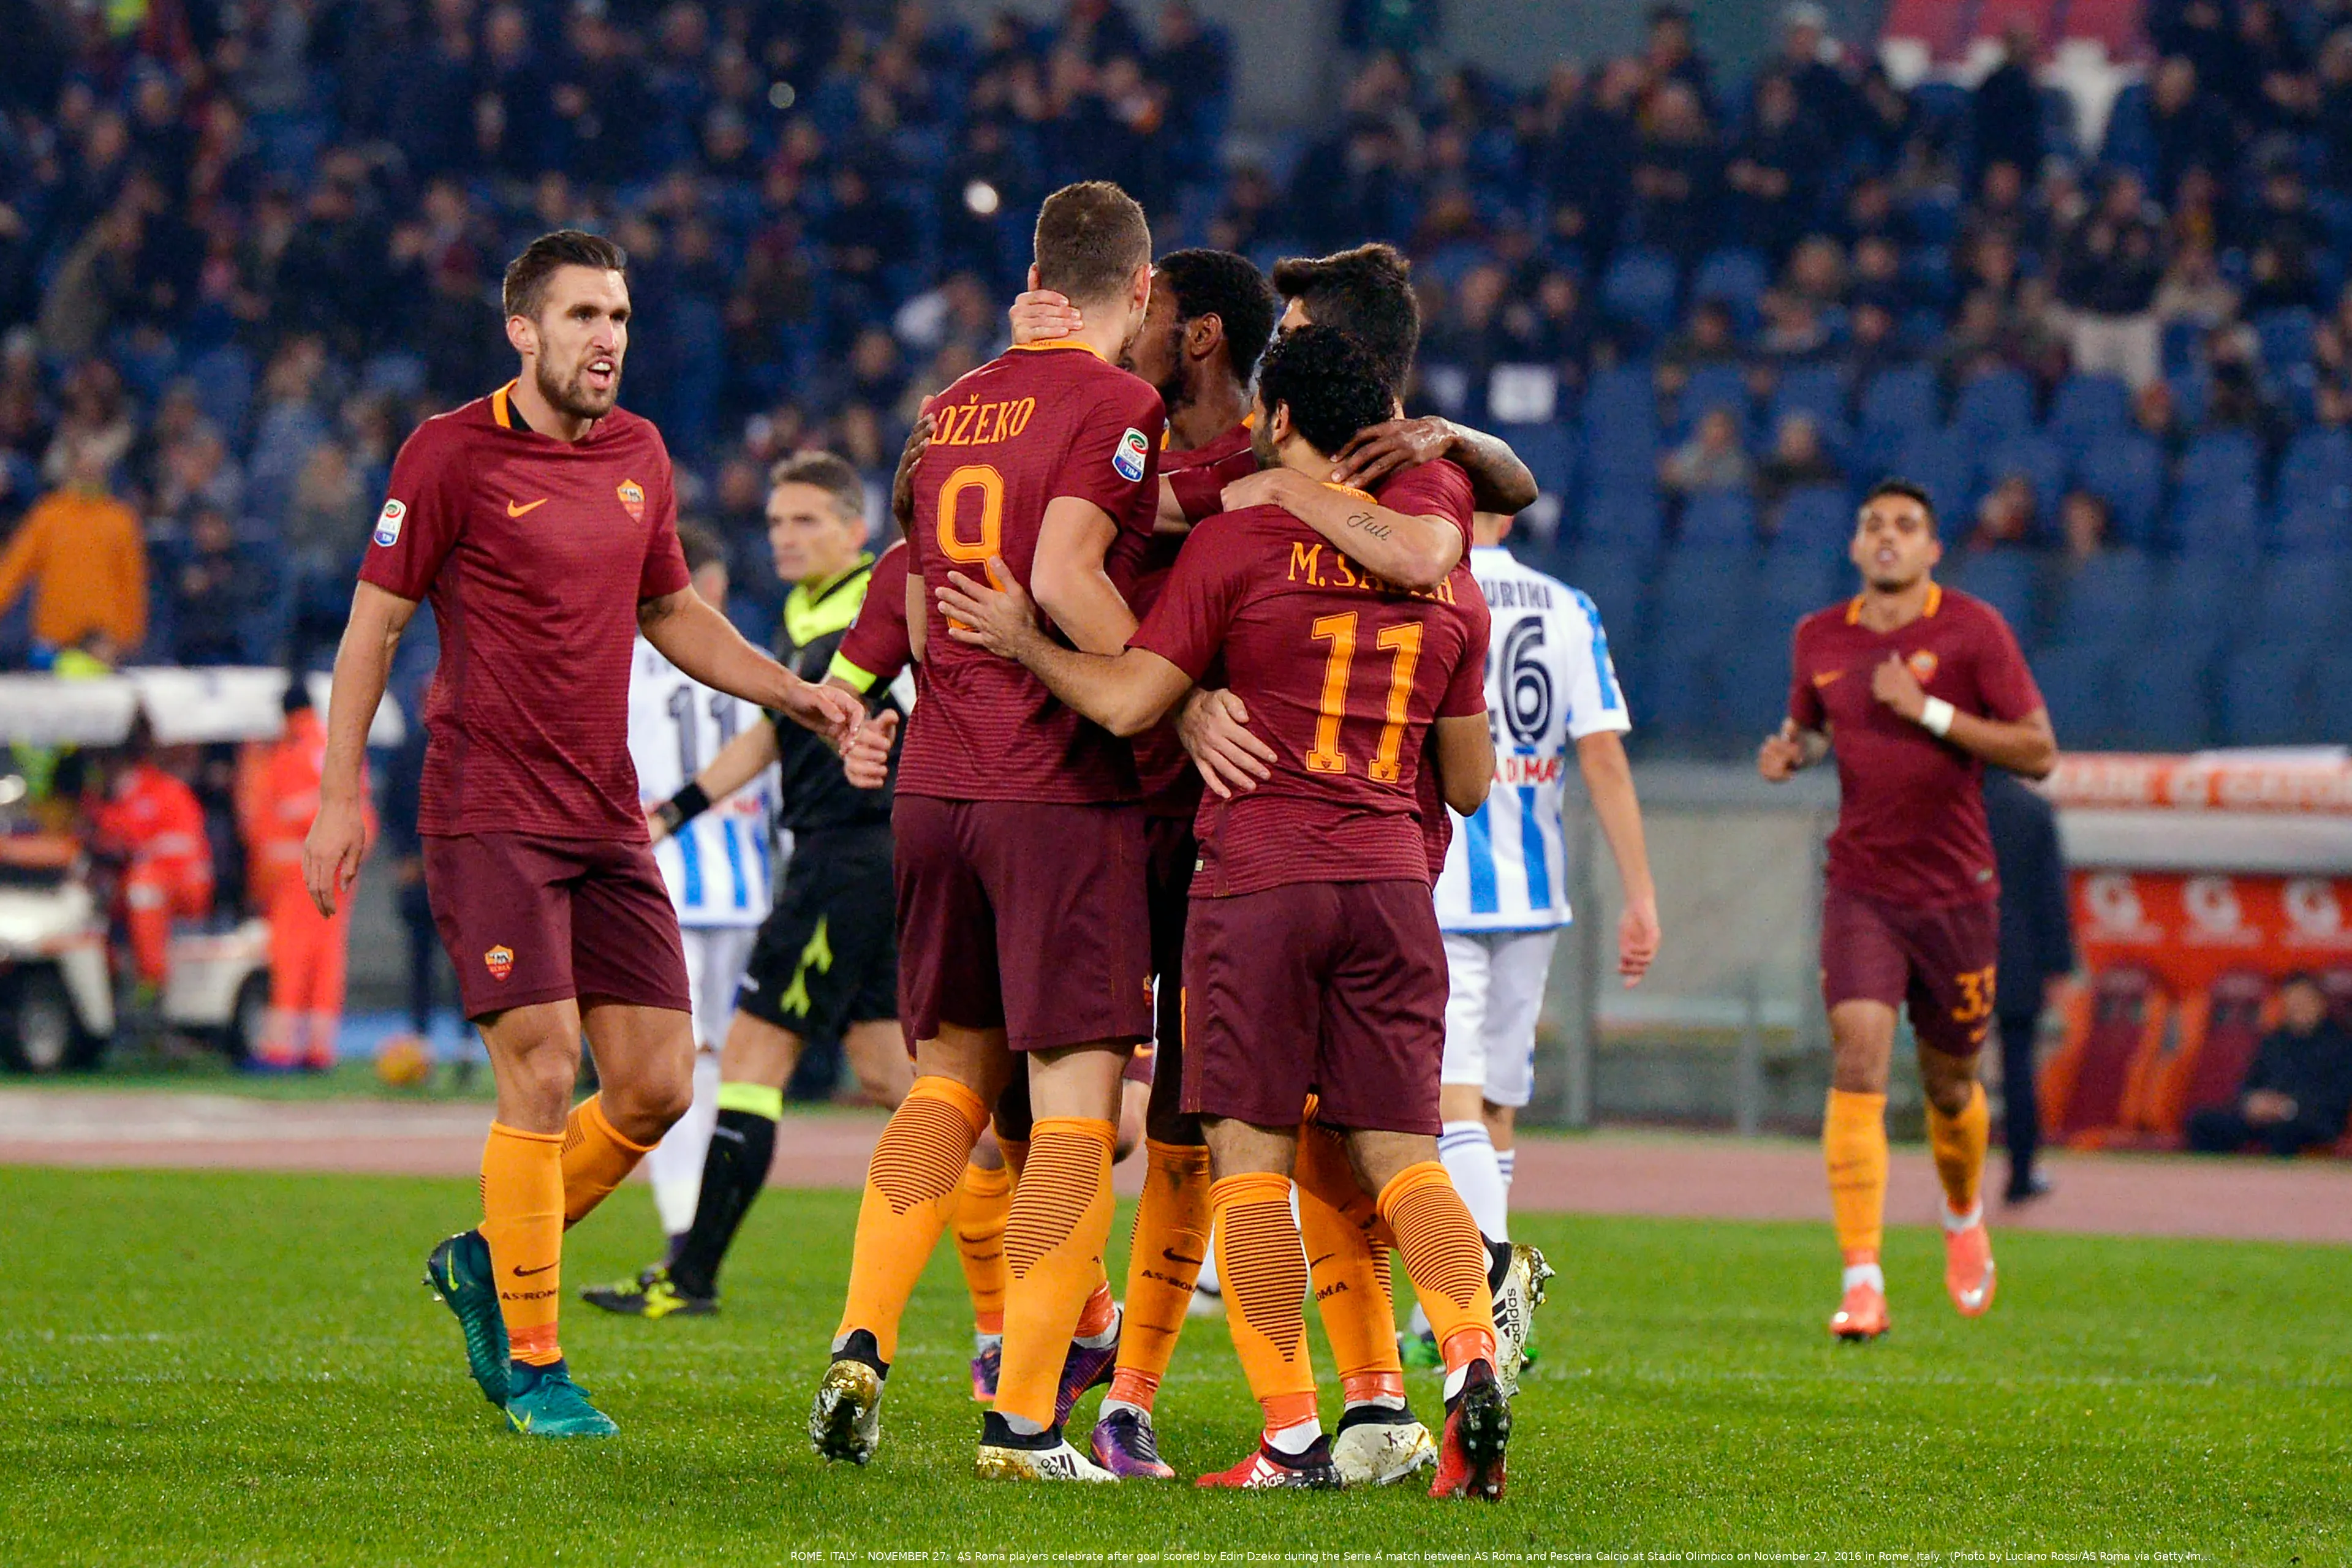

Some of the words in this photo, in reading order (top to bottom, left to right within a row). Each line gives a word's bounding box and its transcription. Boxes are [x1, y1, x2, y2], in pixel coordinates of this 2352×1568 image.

[930, 393, 1035, 446] DŽEKO
[937, 464, 1005, 633] 9
[1347, 511, 1392, 540] Juli
[1306, 611, 1423, 784] 11
[502, 1289, 559, 1300] AS-ROM
[1507, 1288, 1519, 1343] adidas
